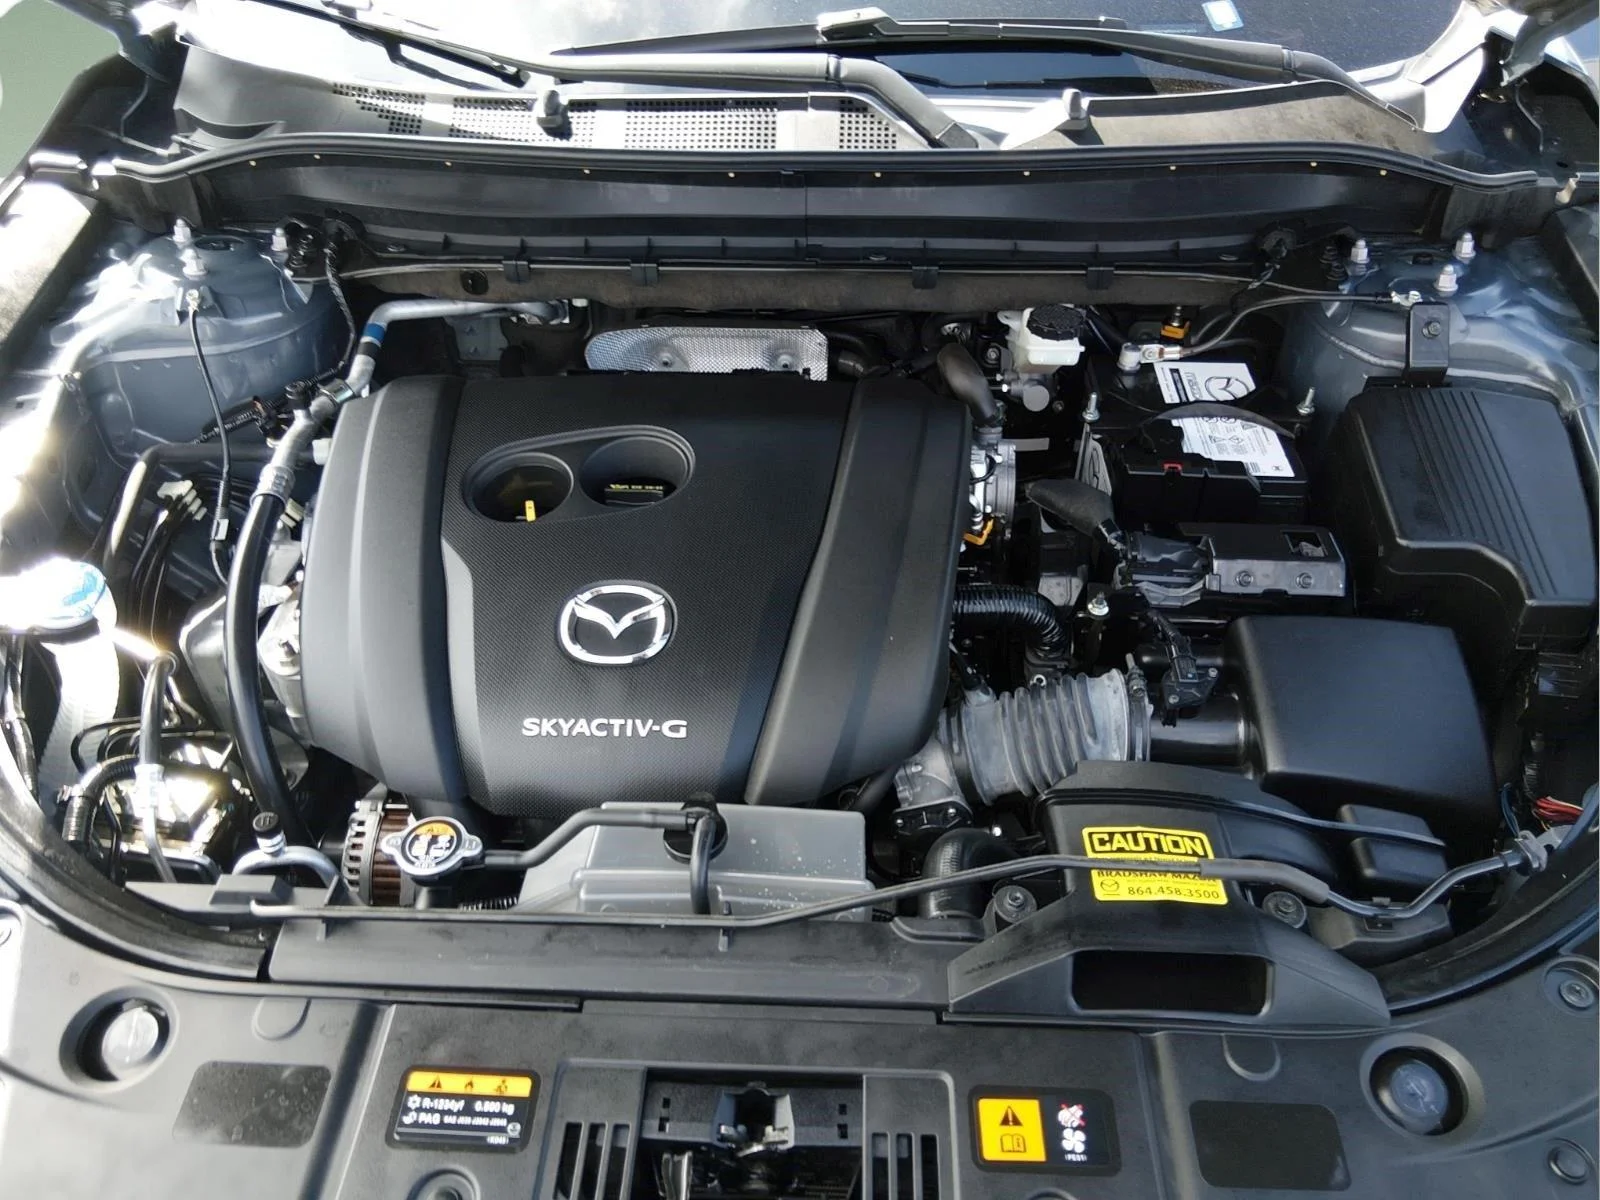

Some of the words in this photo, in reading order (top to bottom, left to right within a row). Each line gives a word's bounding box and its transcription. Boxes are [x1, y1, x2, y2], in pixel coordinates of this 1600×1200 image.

[521, 717, 688, 739] SKYACTIV-G
[1091, 832, 1205, 856] CAUTION
[1127, 885, 1220, 900] 864.458.3500
[418, 1112, 441, 1125] PAG
